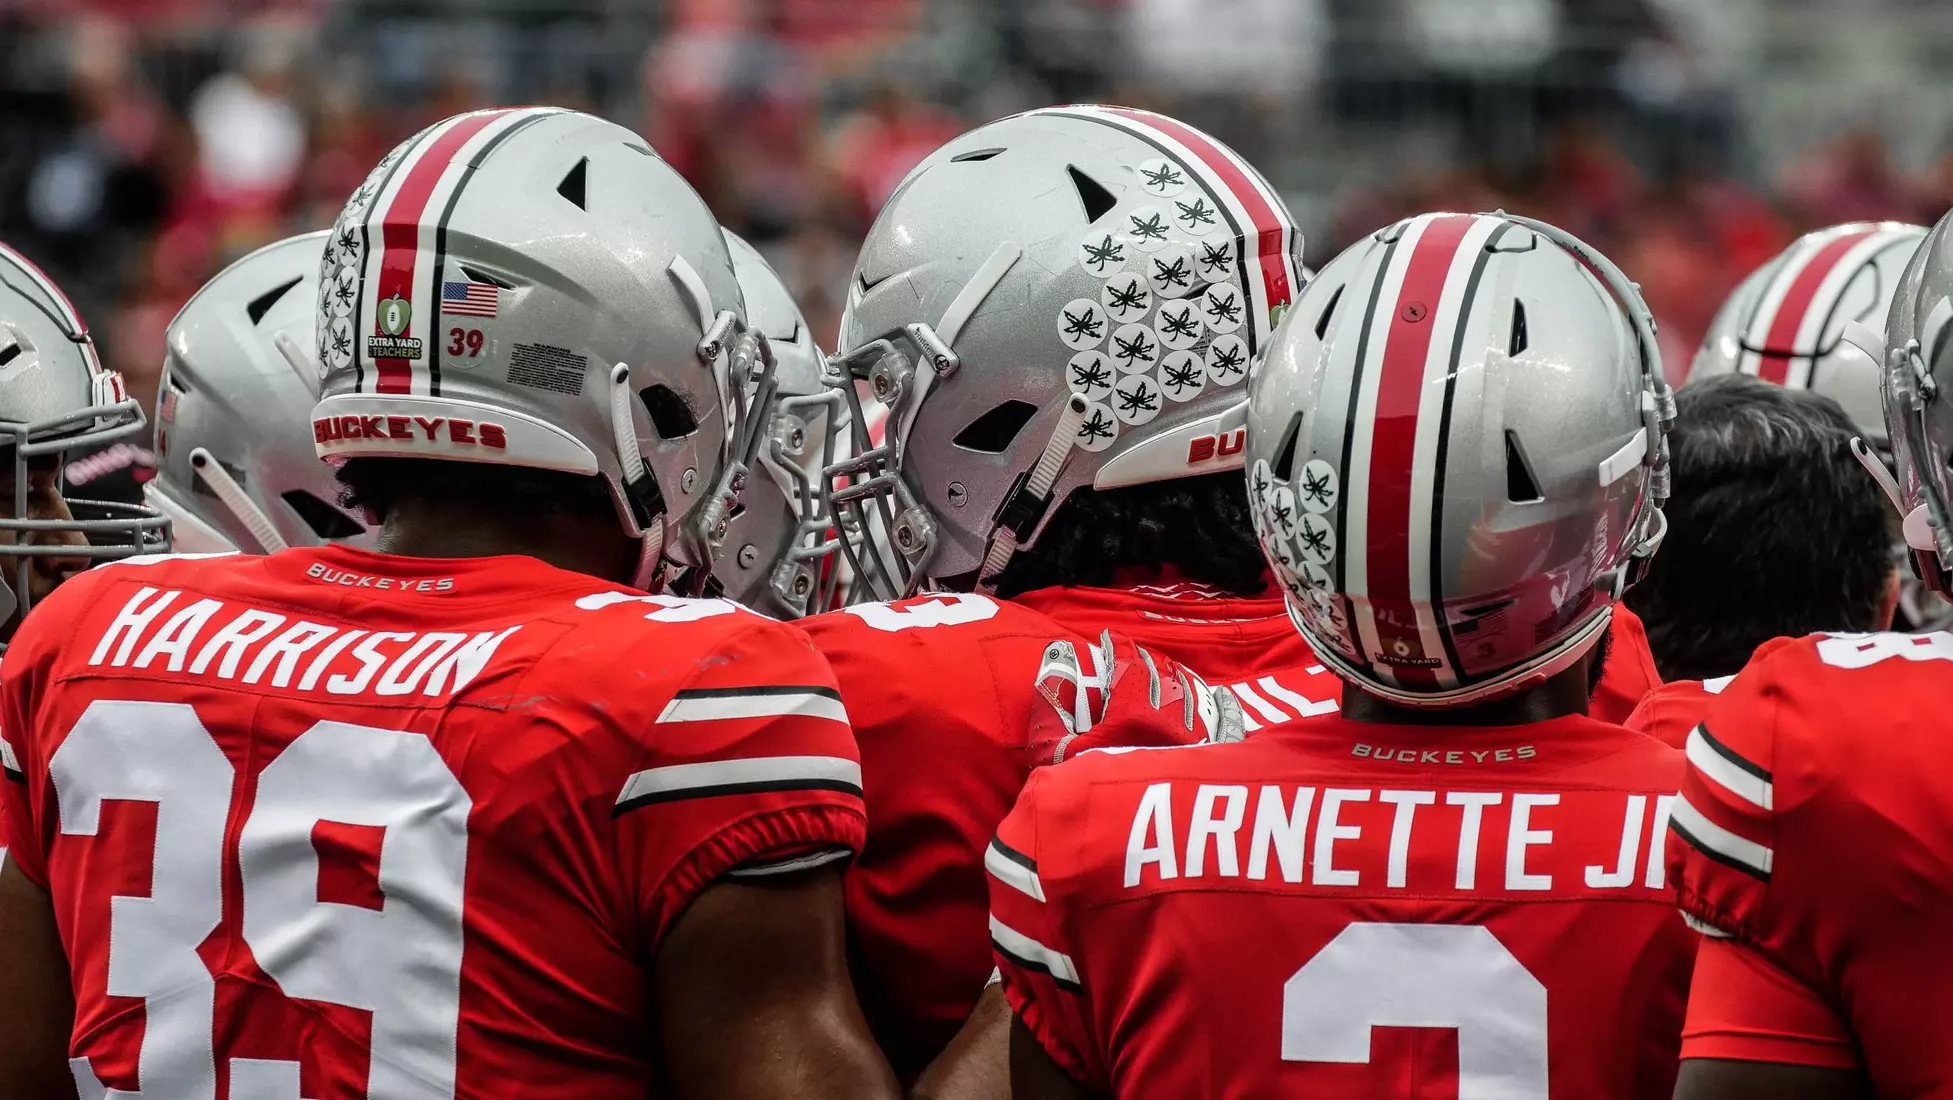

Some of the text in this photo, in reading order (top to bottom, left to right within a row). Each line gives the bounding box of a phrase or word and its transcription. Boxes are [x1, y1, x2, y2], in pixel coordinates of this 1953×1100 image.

[368, 337, 421, 348] EXTRA YARD
[373, 347, 420, 358] TEACHERS
[447, 327, 484, 358] 39
[313, 415, 507, 449] BUCKEYES
[306, 562, 455, 592] BUCKEYES
[88, 587, 522, 697] HARRISON
[1351, 743, 1537, 764] BUCKEYES
[1124, 782, 1560, 891] ARNETTE
[49, 700, 473, 1100] 39
